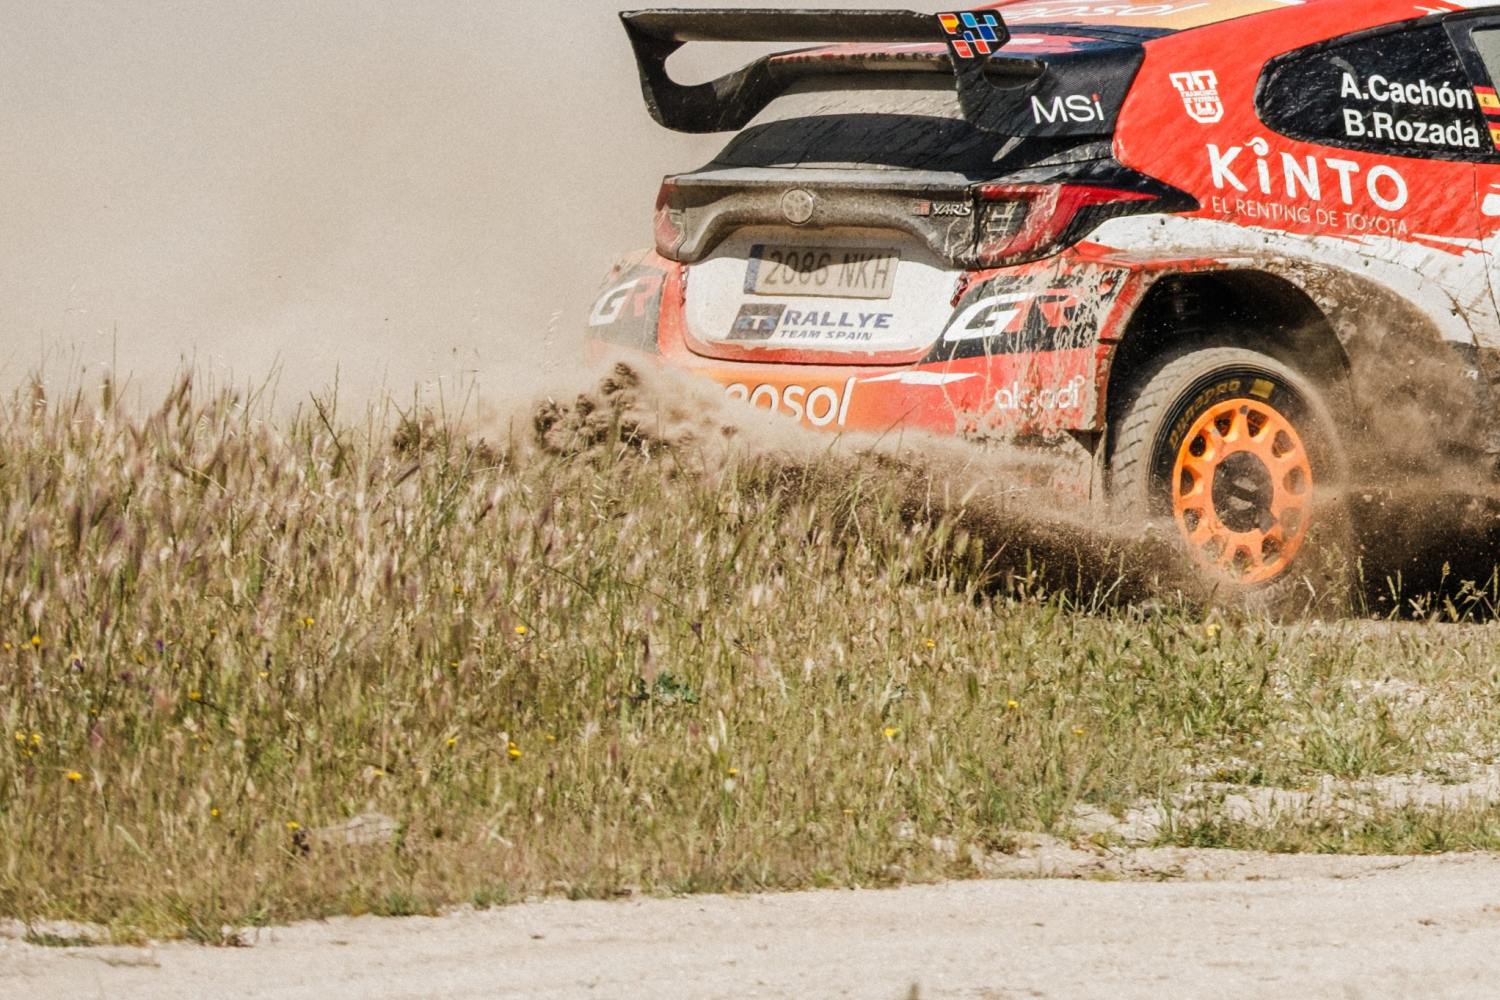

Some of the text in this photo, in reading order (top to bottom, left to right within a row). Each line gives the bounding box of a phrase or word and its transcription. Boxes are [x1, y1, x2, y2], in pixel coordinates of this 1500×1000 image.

[1340, 72, 1474, 110] A.Cachón
[1342, 108, 1480, 148] B.Rozada
[932, 203, 971, 216] YARIS
[1212, 196, 1408, 235] EL RENTING DE TOYOTA
[764, 250, 892, 290] 2086 NKH
[588, 274, 663, 328] GR
[782, 310, 894, 329] RALLYE
[781, 330, 873, 341] TEAM SPAIN
